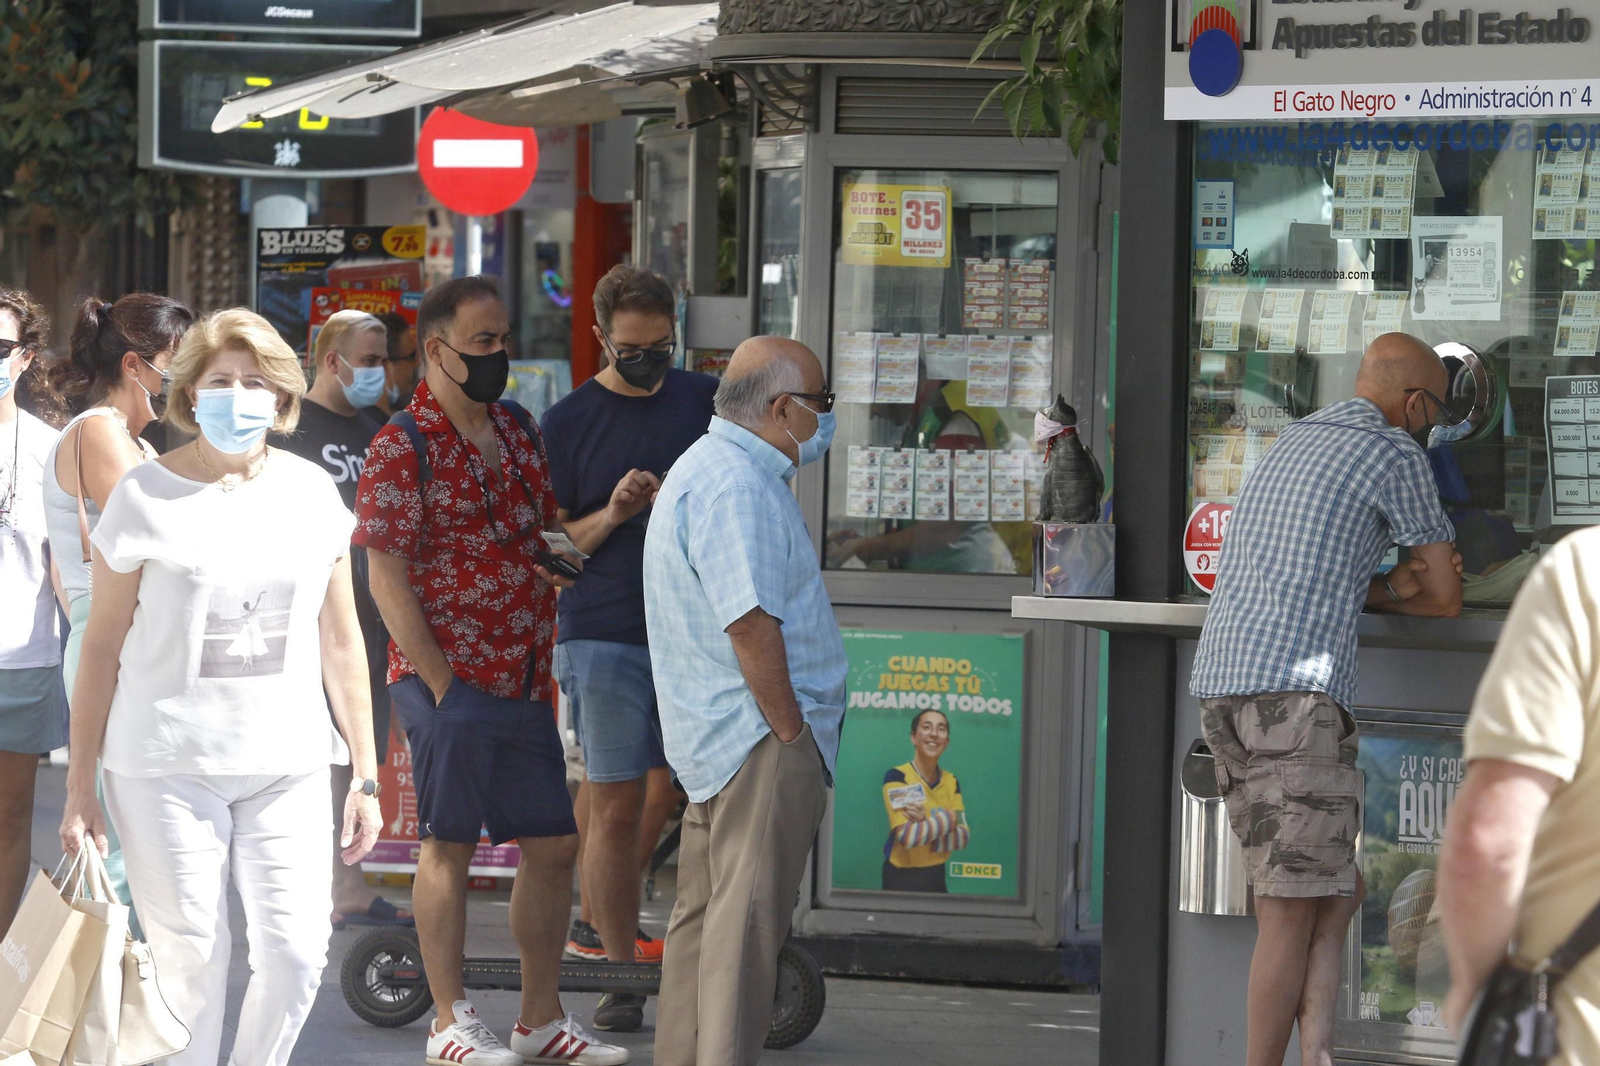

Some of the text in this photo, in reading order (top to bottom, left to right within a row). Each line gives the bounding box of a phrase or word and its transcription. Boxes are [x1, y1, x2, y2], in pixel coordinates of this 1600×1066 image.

[264, 6, 314, 19] JCDecaux
[1271, 8, 1590, 59] Apuestas del Estado
[1273, 90, 1287, 112] El
[1292, 91, 1335, 112] Gato
[1340, 90, 1396, 117] Negro
[1418, 85, 1554, 110] Administración
[1580, 85, 1592, 107] 4
[851, 192, 886, 204] BOTE
[851, 205, 897, 216] viernes
[905, 200, 941, 231] 35
[260, 229, 345, 256] BLUES
[848, 232, 895, 246] JACKPOT
[903, 240, 943, 249] MILLONES
[1449, 248, 1482, 257] 13954
[1252, 268, 1369, 280] www.la4decordoba.com
[1570, 380, 1599, 395] BOTES
[1198, 510, 1232, 539] +18
[888, 655, 972, 675] CUANDO
[878, 673, 950, 692] JUEGAS
[848, 691, 1013, 716] JUGAMOS TODOS
[1400, 755, 1417, 780] ¿Y
[1421, 756, 1435, 781] SI
[1399, 780, 1457, 843] AQU
[1398, 843, 1405, 853] EL
[1406, 843, 1425, 854] GORDO
[965, 865, 998, 876] ONCE
